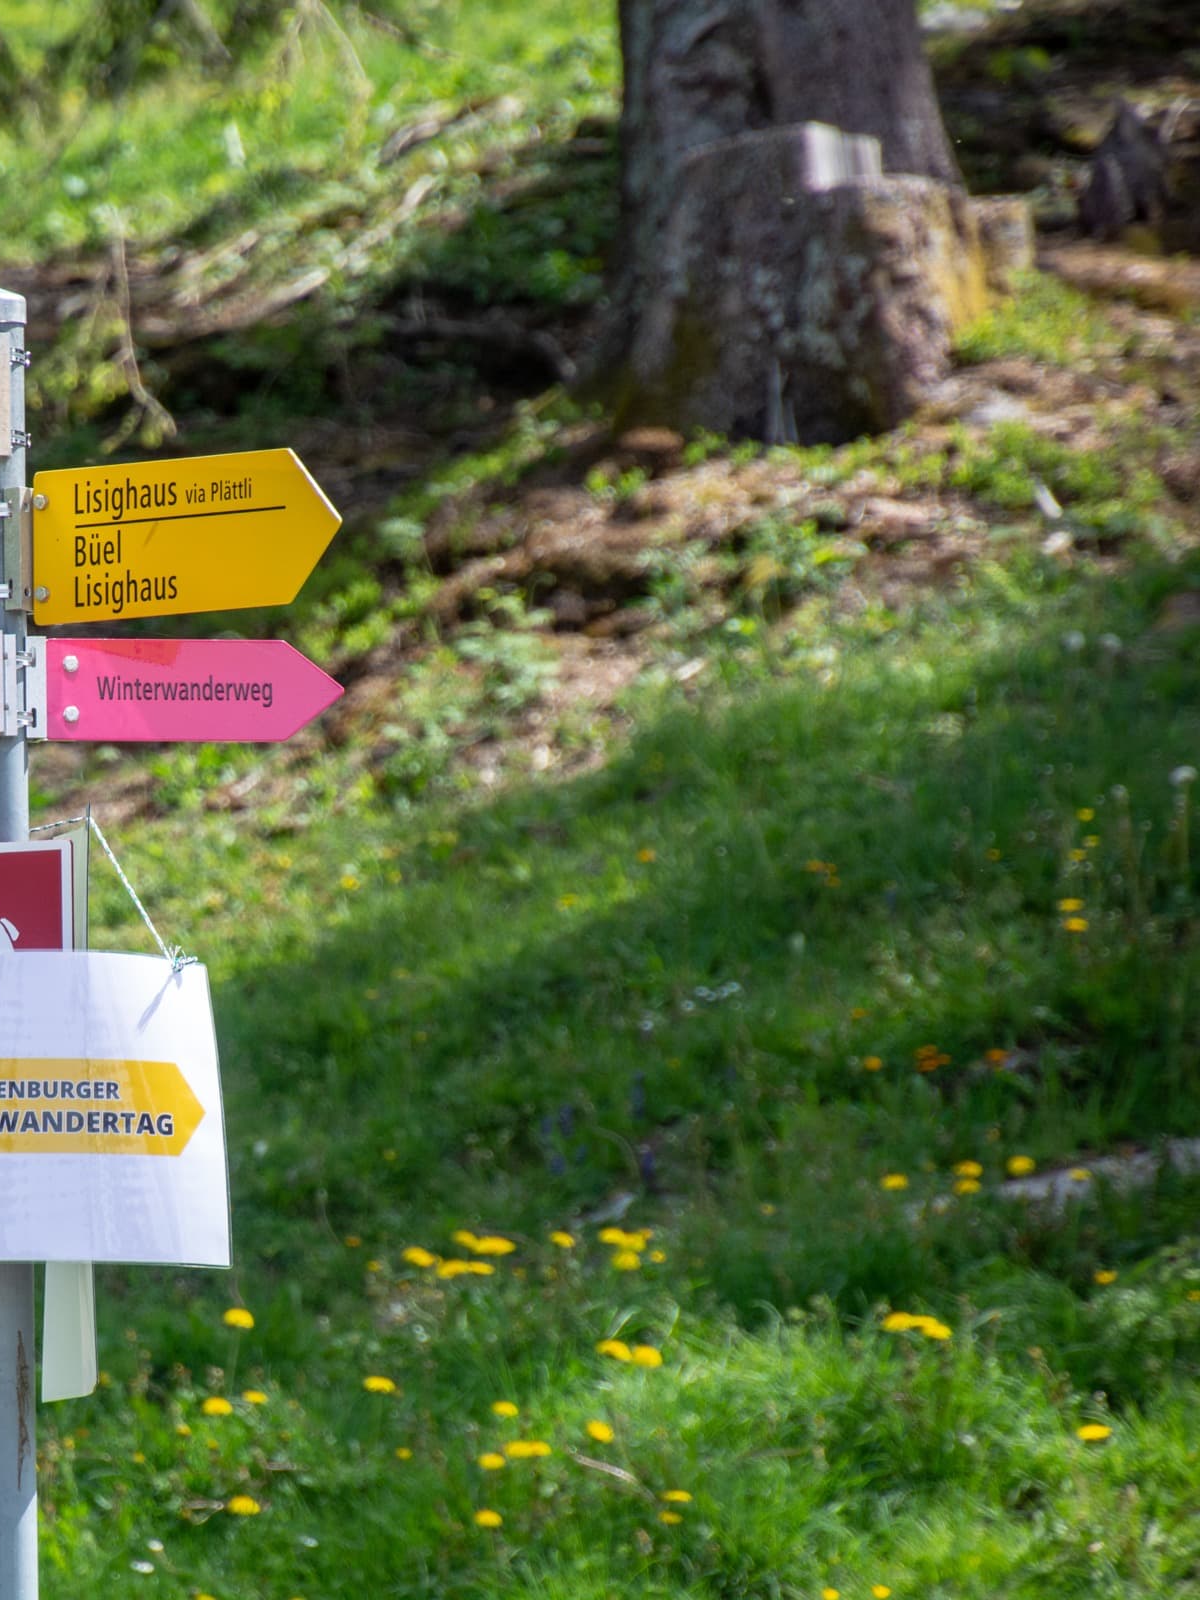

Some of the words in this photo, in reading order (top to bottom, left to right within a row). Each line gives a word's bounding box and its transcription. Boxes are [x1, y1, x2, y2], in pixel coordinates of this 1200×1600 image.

[74, 478, 178, 521] Lisighaus
[185, 483, 206, 505] via
[211, 477, 253, 502] Plättli
[74, 530, 122, 567] Büel
[74, 569, 178, 614] Lisighaus
[96, 675, 274, 708] Winterwanderweg
